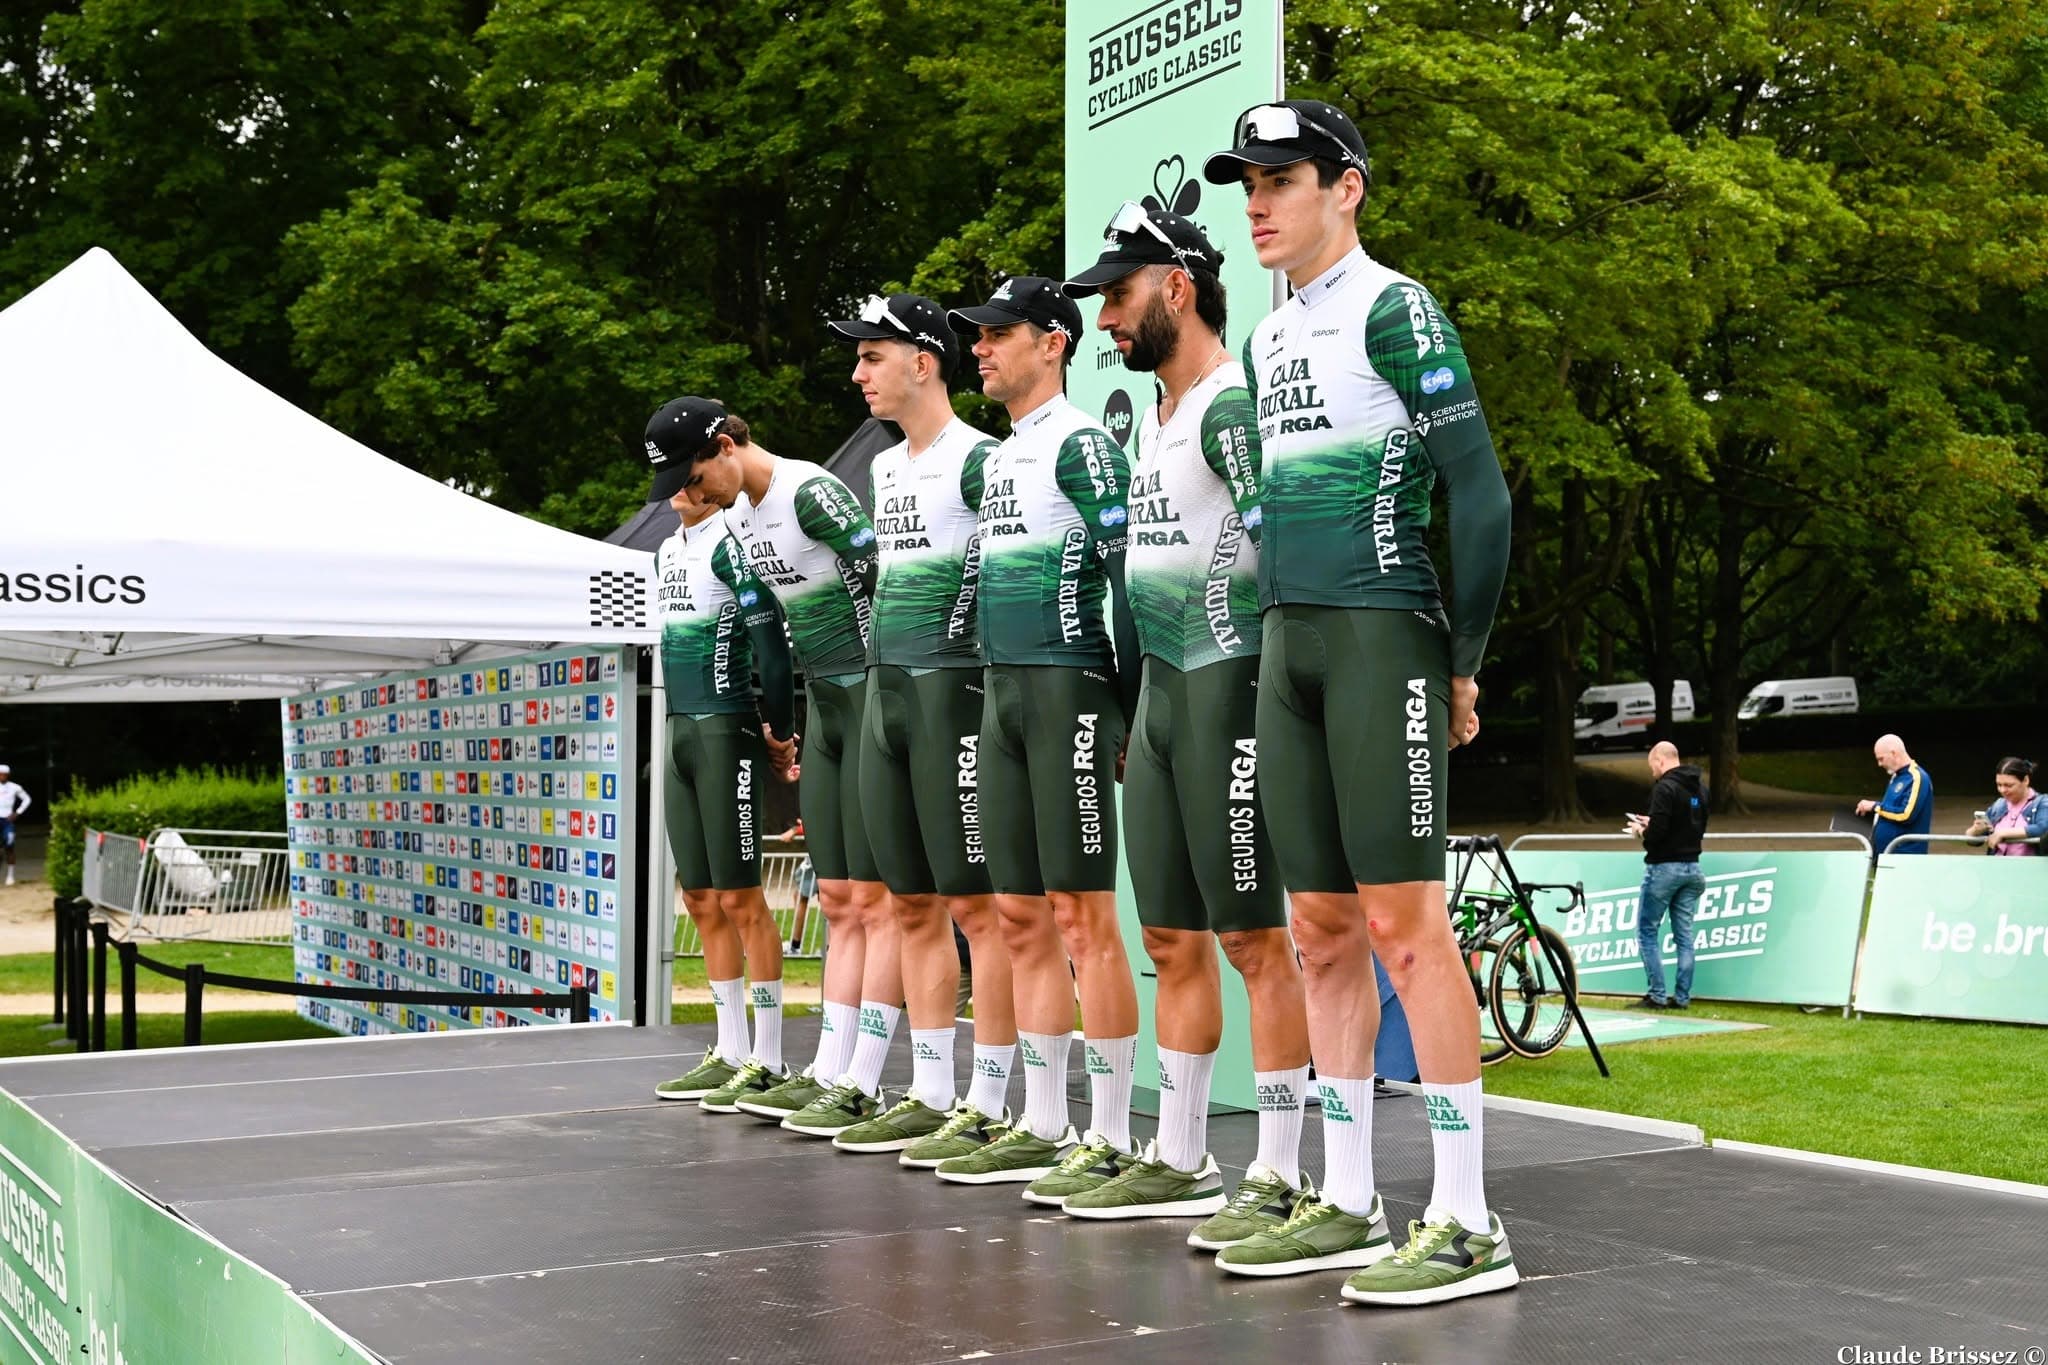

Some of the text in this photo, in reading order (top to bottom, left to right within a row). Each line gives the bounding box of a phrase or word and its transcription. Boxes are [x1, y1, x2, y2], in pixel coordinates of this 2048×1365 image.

[1089, 0, 1242, 86] BRUSSELS
[1088, 30, 1242, 118] CYCLING CLASSIC
[1400, 286, 1432, 360] RGA
[1418, 289, 1446, 355] SEGUROS
[1270, 358, 1311, 389] CAJA
[1422, 373, 1453, 389] KMC
[1259, 385, 1325, 421] RURAL
[1105, 411, 1131, 433] lotto
[1280, 415, 1333, 435] RGA
[1078, 434, 1106, 500] RGA
[1094, 435, 1119, 496] SEGUROS
[1217, 428, 1245, 501] RGA
[1233, 425, 1258, 496] SEGUROS
[822, 481, 859, 523] SEGUROS
[985, 478, 1014, 501] CAJA
[1131, 470, 1163, 499] CAJA
[1373, 428, 1409, 574] CAJA RURAL
[808, 483, 849, 531] RGA
[884, 495, 917, 514] CAJA
[1100, 509, 1127, 522] KMC
[1128, 497, 1180, 526] URAL
[876, 515, 926, 536] RURAL
[992, 523, 1029, 537] RGA
[1137, 529, 1190, 546] RGA
[724, 537, 745, 586] RGA
[751, 541, 777, 560] CAJA
[894, 537, 932, 551] RGA
[658, 585, 692, 601] RURAL
[664, 568, 687, 584] CAJA
[776, 574, 808, 586] RGA
[836, 558, 863, 597] CAJA
[1059, 528, 1086, 644] CAJA RURAL
[1205, 511, 1244, 654] CAJA RURAL
[669, 602, 696, 612] RGA
[948, 584, 976, 639] RURAL
[714, 602, 737, 694] CAJA RURAL
[1406, 678, 1433, 838] SEGUROS RGA
[958, 735, 986, 864] SEGUROS RGA
[1073, 713, 1102, 854] SEGUROS RGA
[737, 759, 754, 861] SEGUROS RGA
[1229, 738, 1257, 892] SEGUROS RGA
[1561, 880, 1774, 938] BRUELS
[1662, 922, 1768, 954] CASSIC
[869, 1030, 888, 1039] RGA
[1258, 1084, 1291, 1095] CAJA
[1424, 1094, 1454, 1107] AJA
[1326, 1112, 1354, 1122] RGA
[1428, 1108, 1464, 1121] RAL
[1440, 1123, 1470, 1131] RGA
[0, 1169, 67, 1306] USSELS
[25, 1286, 71, 1365] CLASSIC
